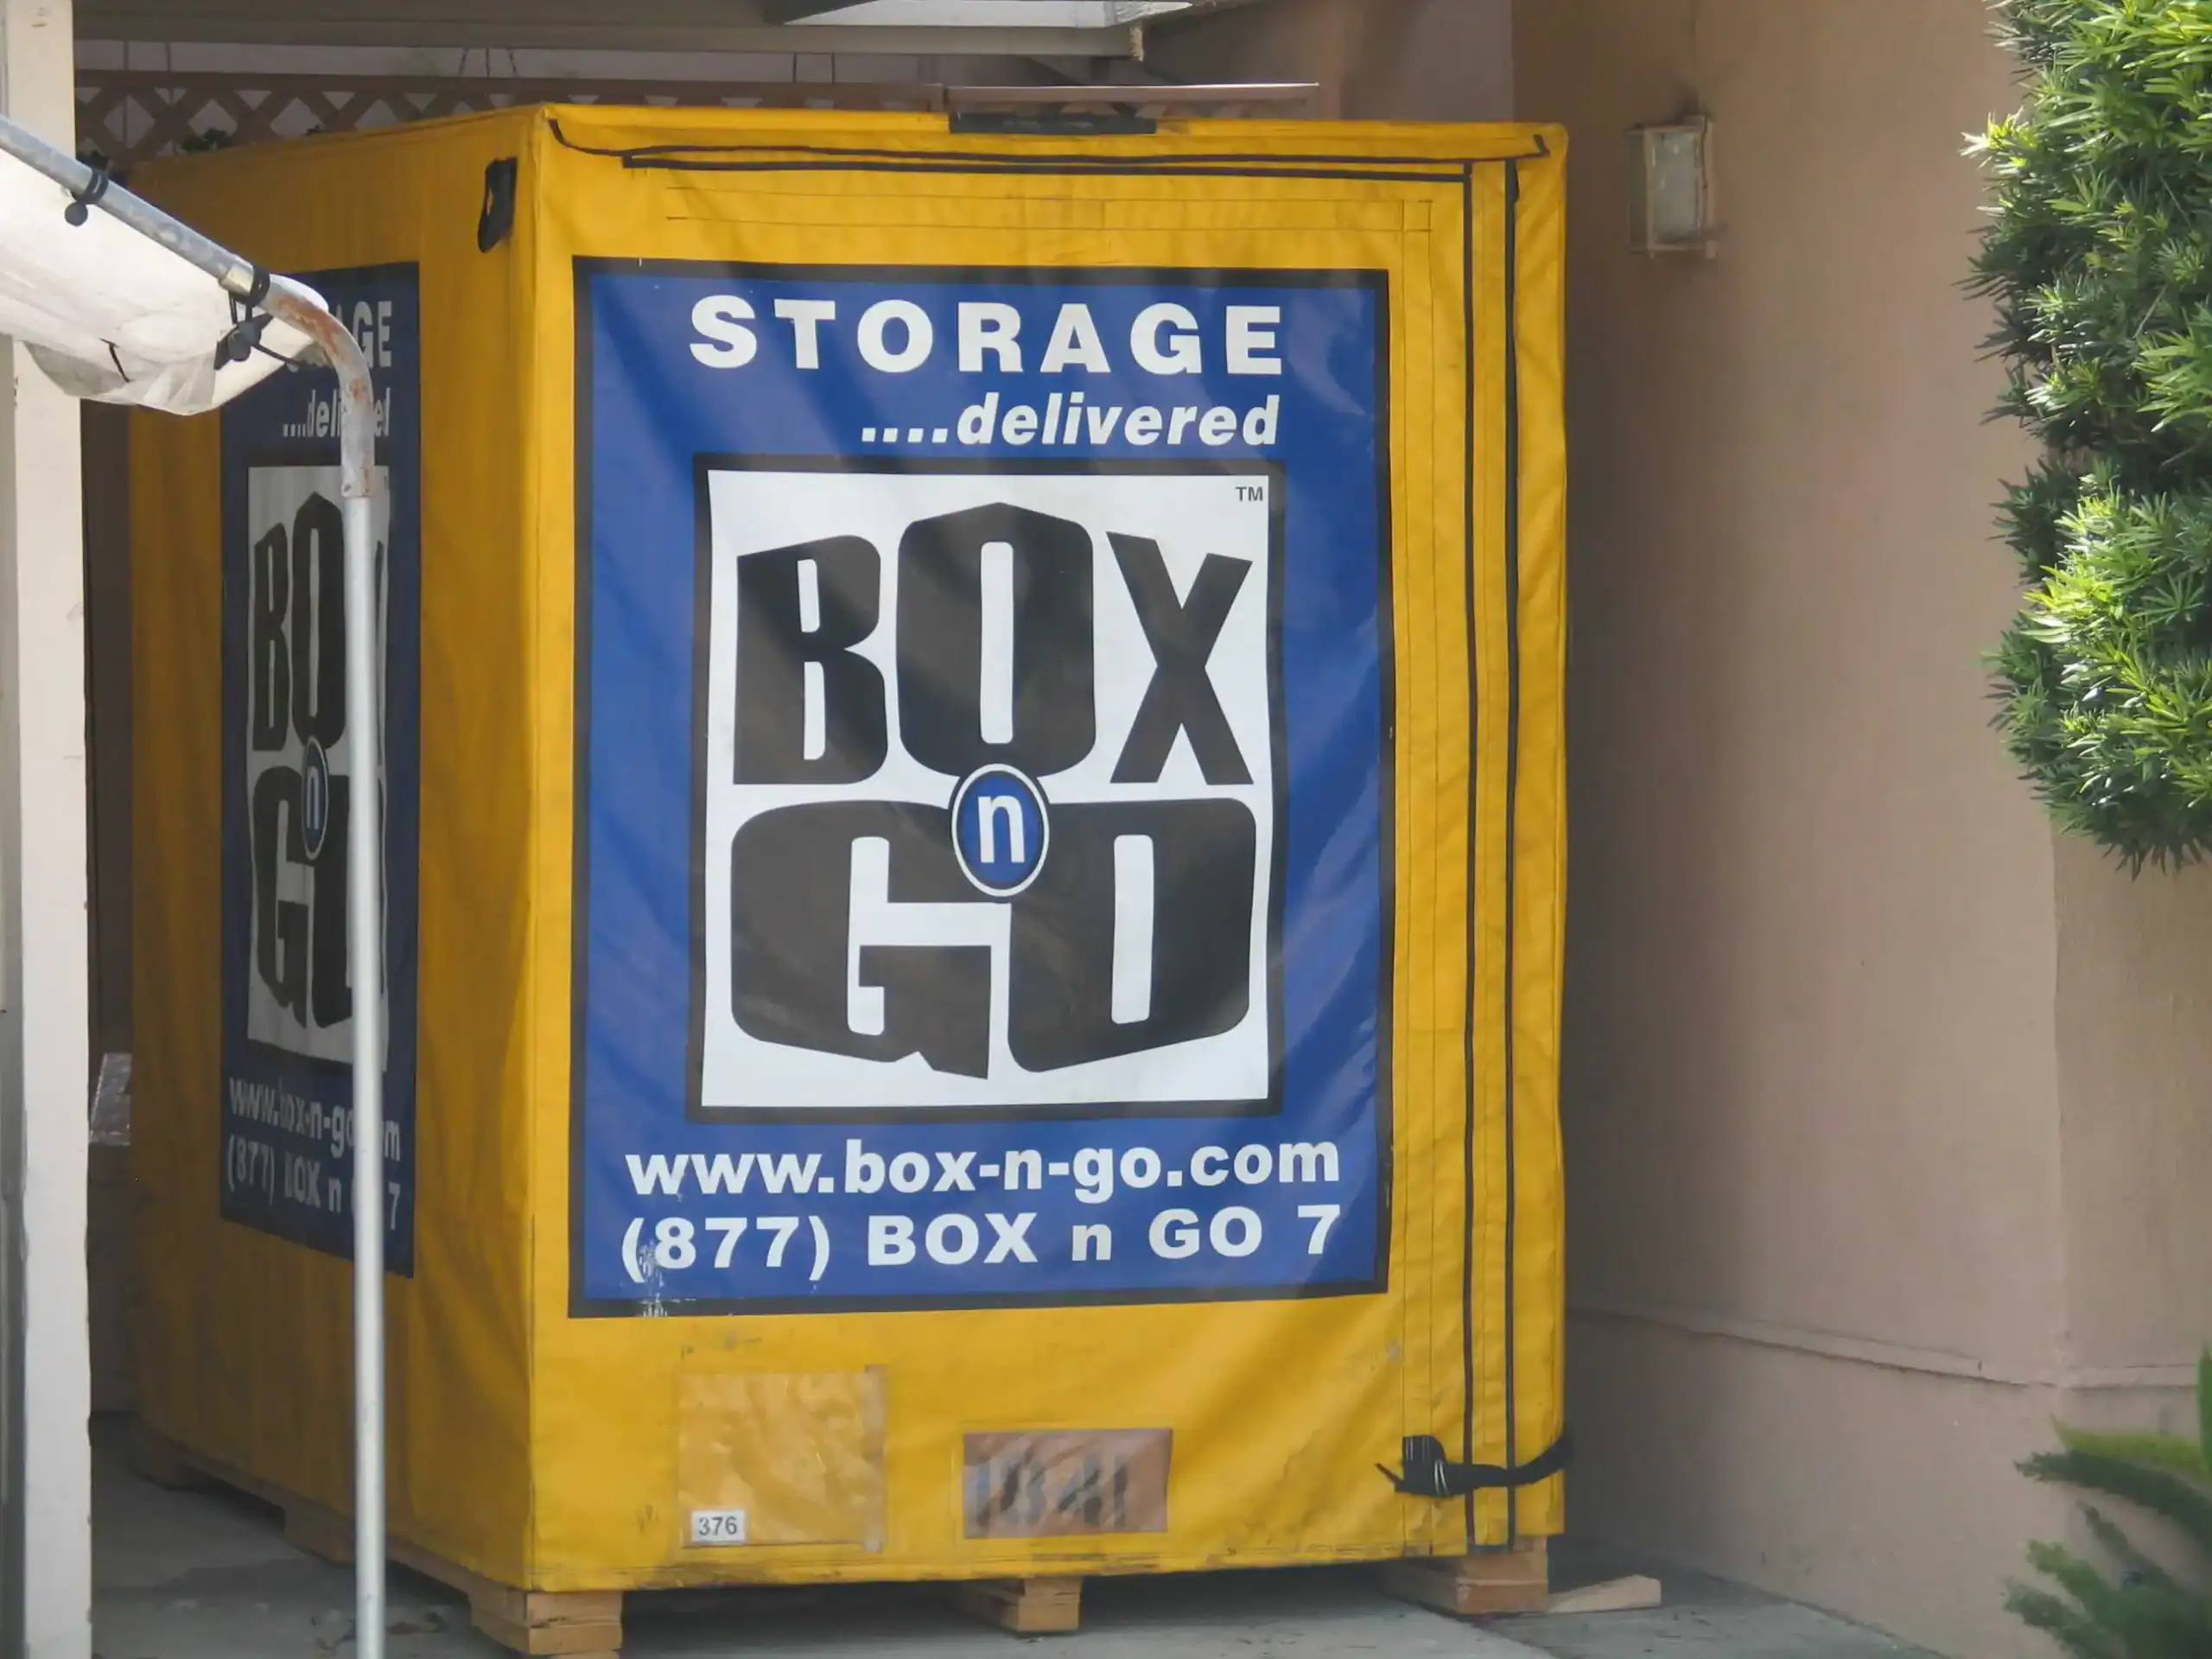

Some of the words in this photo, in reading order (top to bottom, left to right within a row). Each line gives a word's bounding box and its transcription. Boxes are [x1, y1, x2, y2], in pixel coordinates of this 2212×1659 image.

[690, 294, 1282, 376] STORAGE
[1235, 486, 1263, 502] TM
[733, 501, 1254, 785] BOX
[978, 795, 1025, 863] n
[731, 797, 1256, 1080] GO
[625, 1139, 1340, 1204] www.box-n-go.com
[621, 1216, 831, 1282] (877)
[867, 1212, 1039, 1267] BOX
[1071, 1223, 1112, 1262] n
[1148, 1206, 1263, 1259] GO
[1298, 1205, 1342, 1255] 7
[698, 1516, 738, 1536] 376
